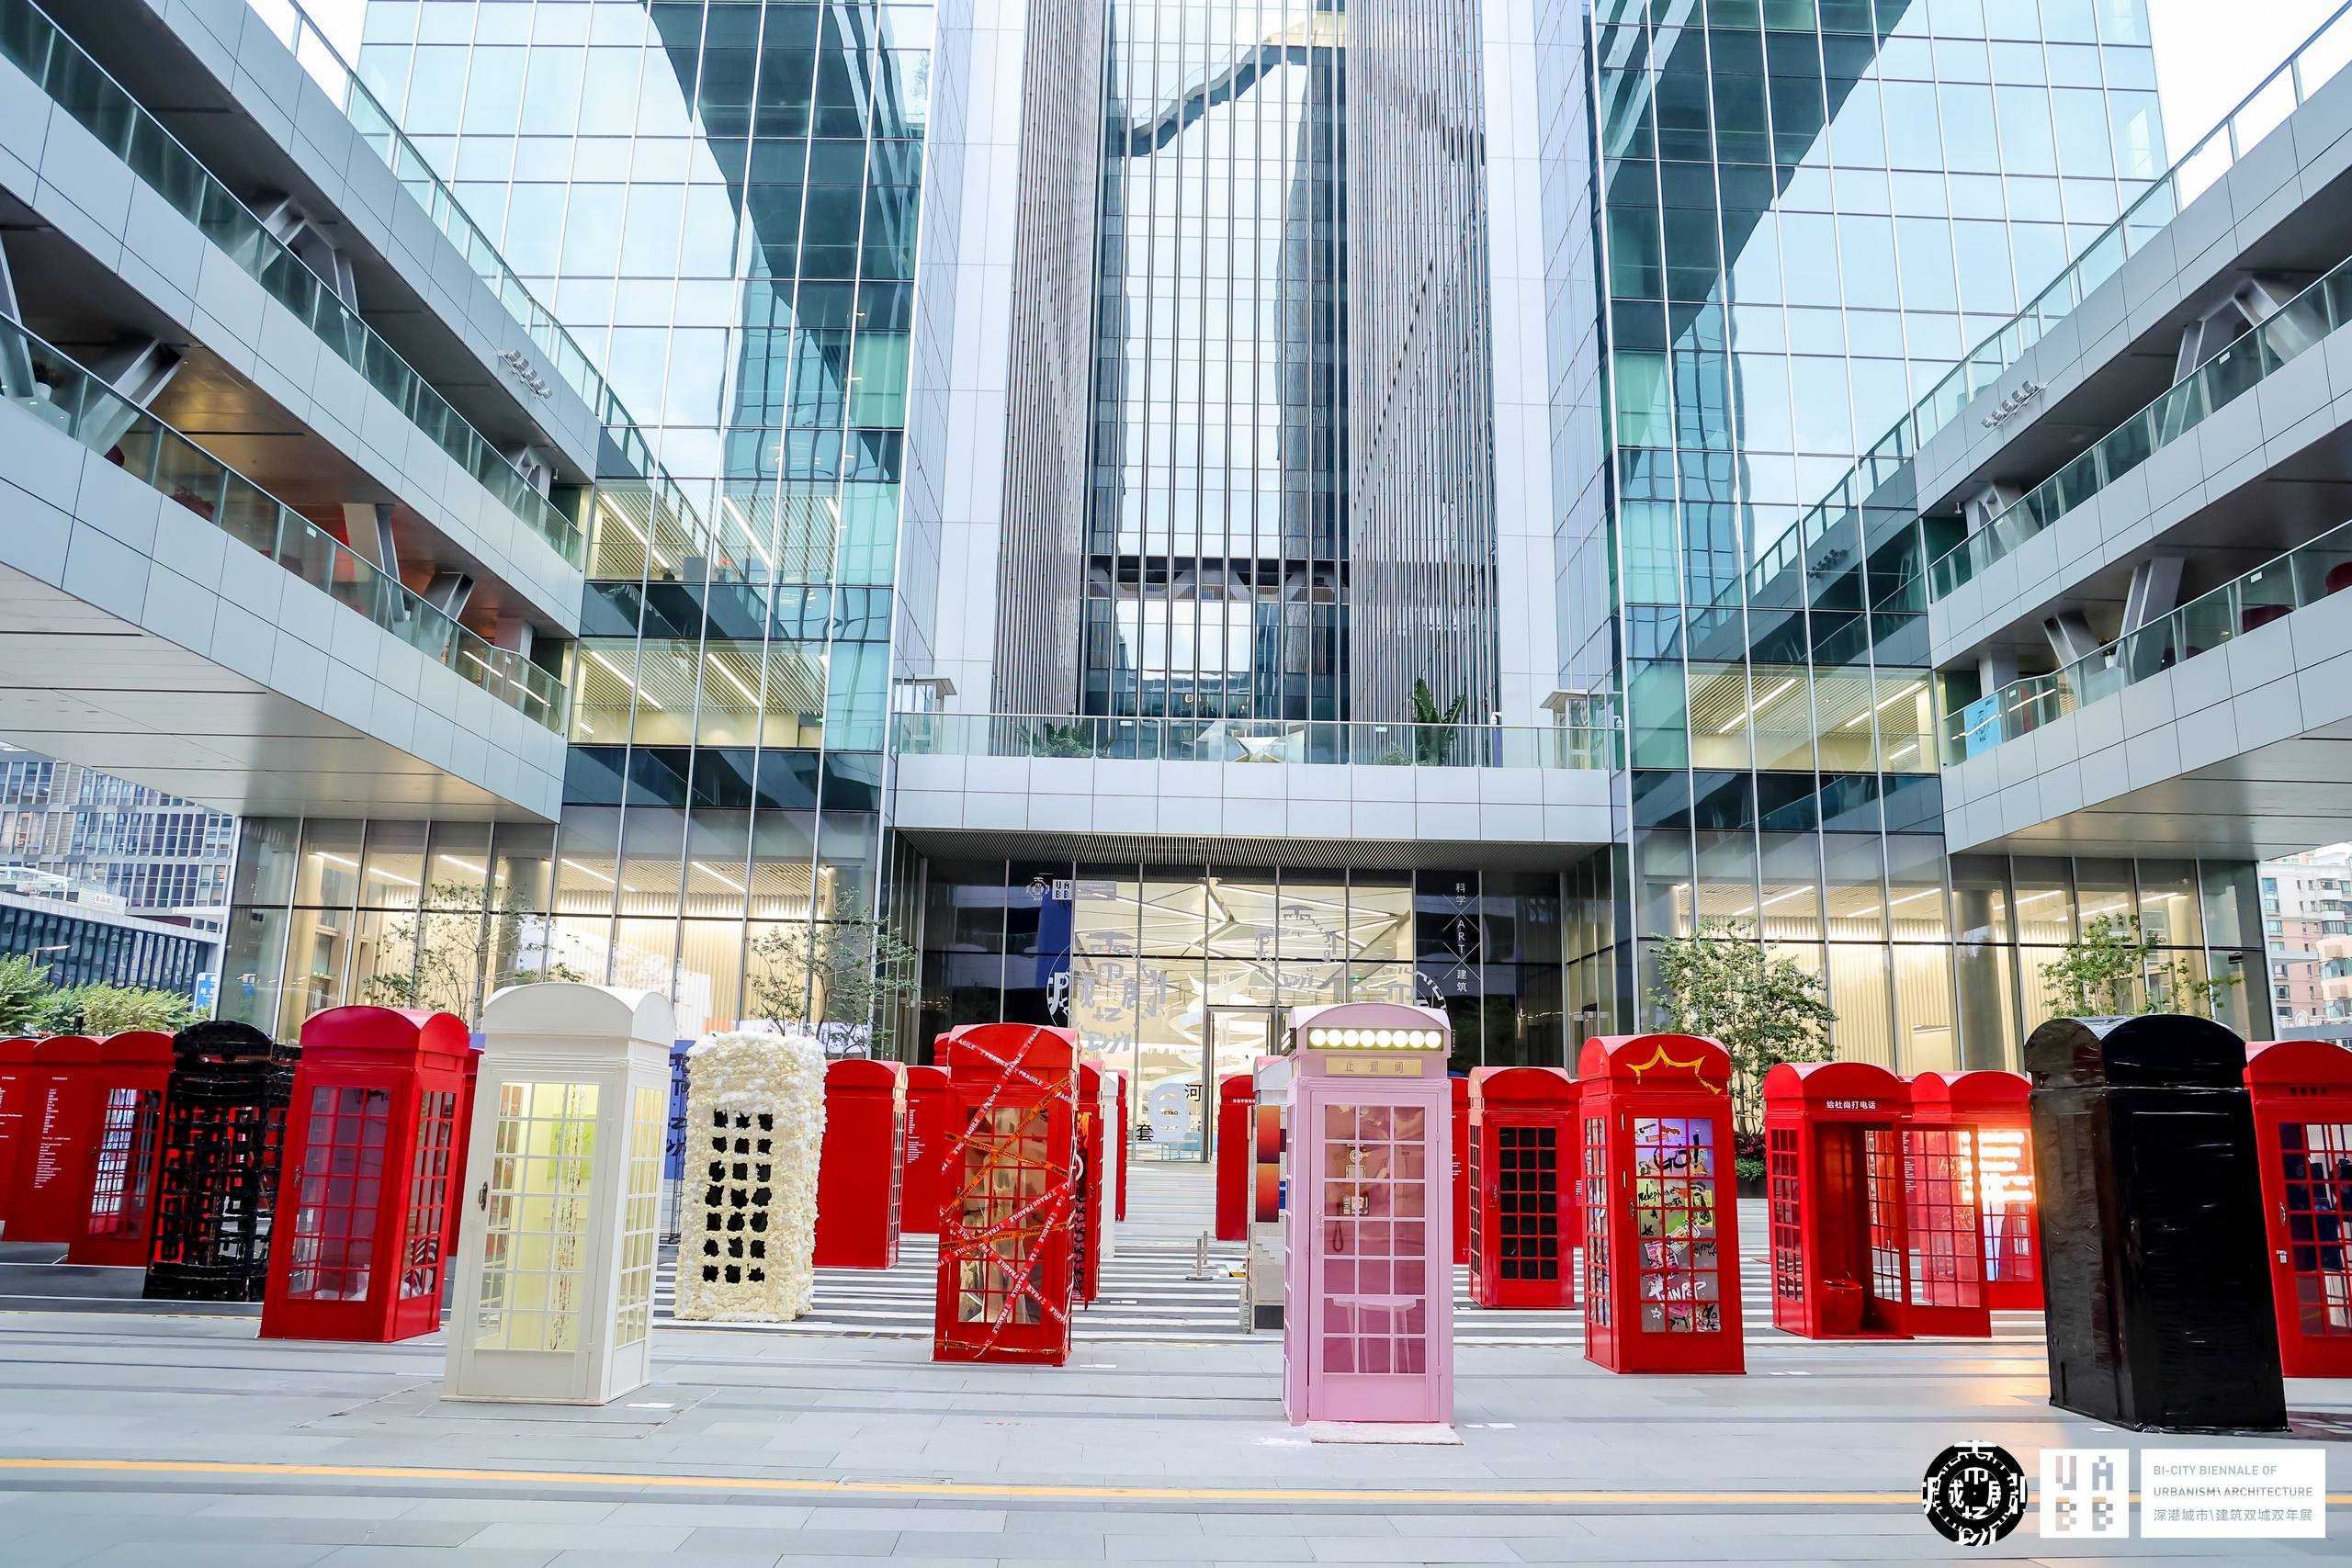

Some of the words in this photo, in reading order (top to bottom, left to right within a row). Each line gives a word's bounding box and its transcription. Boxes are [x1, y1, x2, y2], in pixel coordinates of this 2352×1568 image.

[1455, 883, 1466, 906] 科学
[1457, 919, 1465, 953] ART
[1456, 970, 1467, 992] 建筑
[1019, 1070, 1044, 1086] FRAGILE
[1184, 1084, 1203, 1102] 河
[1826, 1100, 1876, 1109] 给杜尚打电话
[1136, 1124, 1154, 1142] 套
[1009, 1205, 1034, 1223] FRAGILE
[1038, 1216, 1055, 1244] FRAGILE
[997, 1258, 1019, 1280] FRAGILE
[1011, 1271, 1027, 1298] FRAGILE
[992, 1308, 1009, 1334] FRAGILE
